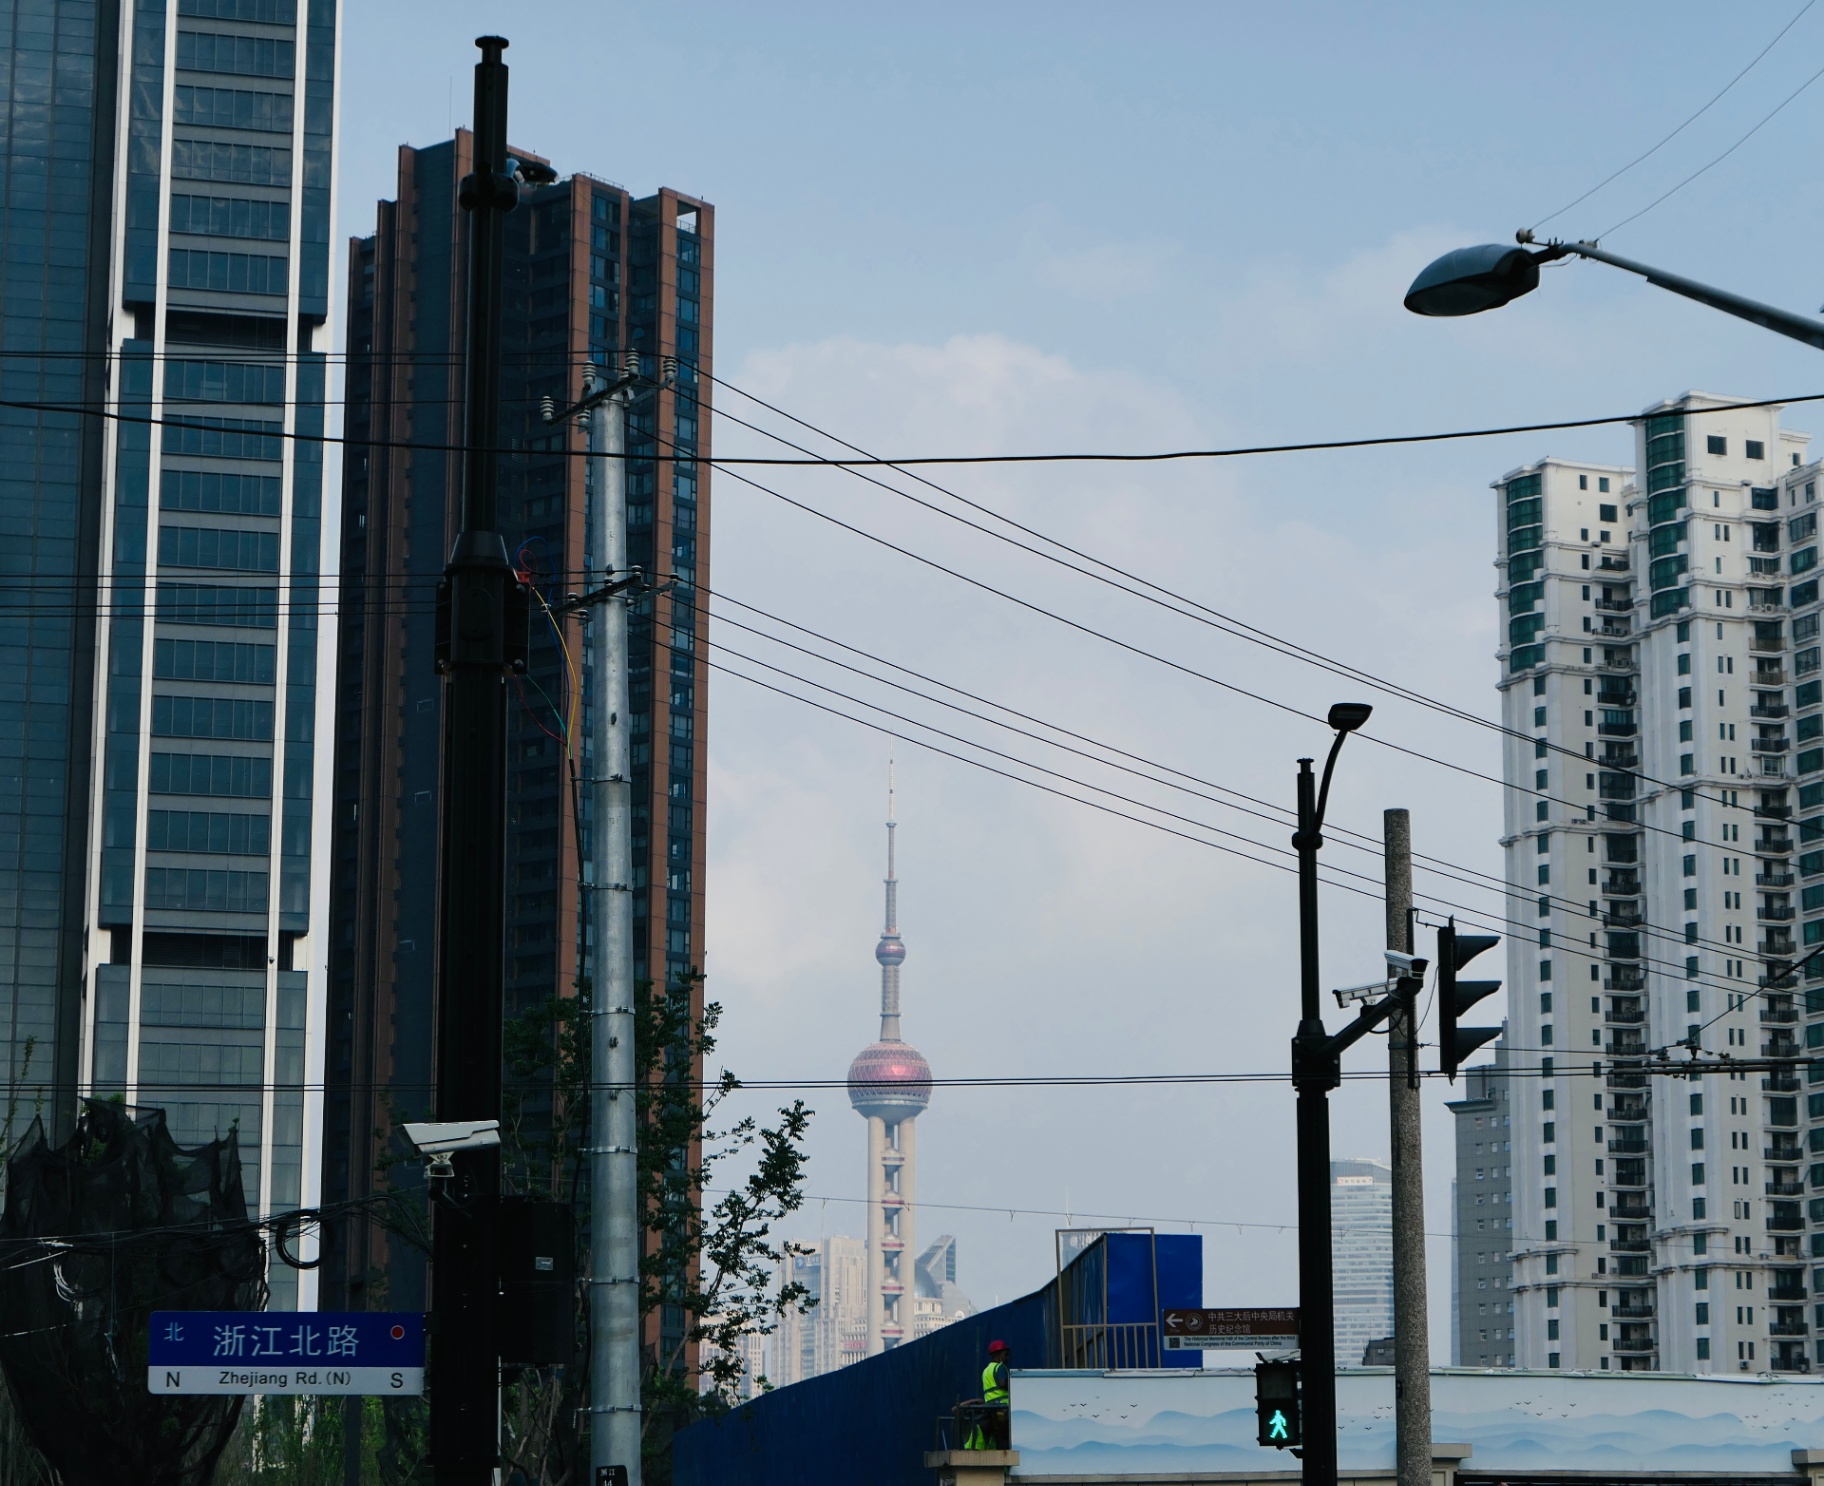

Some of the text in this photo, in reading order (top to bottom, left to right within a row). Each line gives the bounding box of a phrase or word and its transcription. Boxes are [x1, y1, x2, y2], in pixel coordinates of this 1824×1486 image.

[1208, 1311, 1294, 1322] 中共三大后中央局机关
[164, 1322, 184, 1342] 北
[1209, 1324, 1251, 1335] 历史纪念馆
[213, 1324, 359, 1357] 浙江北路
[166, 1371, 180, 1387] N
[219, 1371, 288, 1388] Zhejiang
[390, 1372, 404, 1388] S
